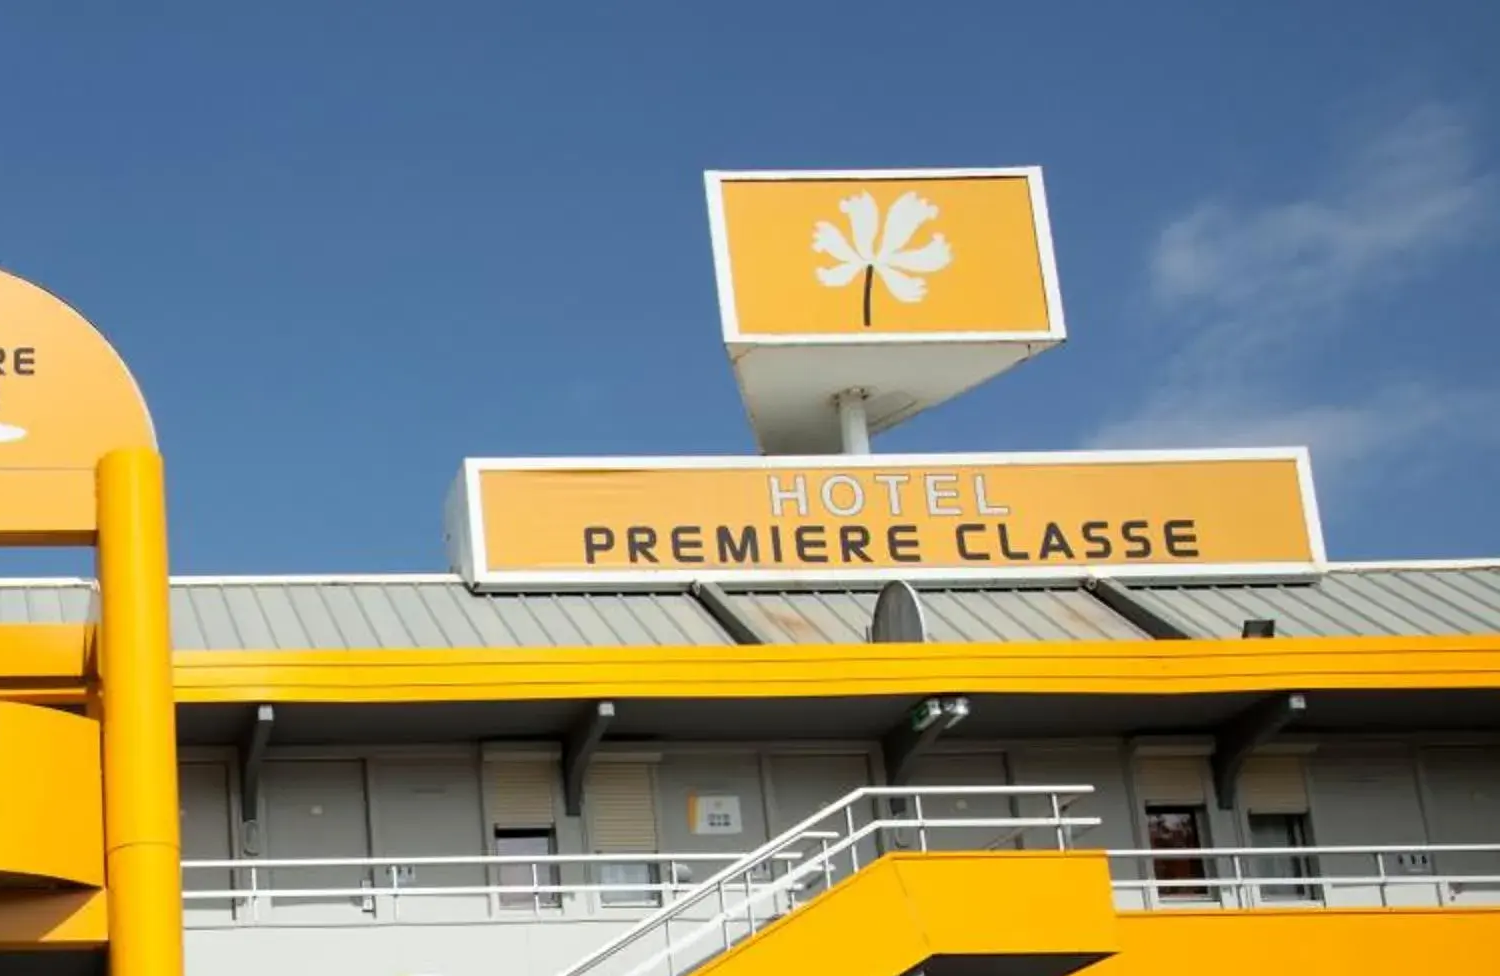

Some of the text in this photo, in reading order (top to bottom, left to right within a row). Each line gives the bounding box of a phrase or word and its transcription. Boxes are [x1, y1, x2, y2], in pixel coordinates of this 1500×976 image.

[767, 473, 1012, 518] HOTEL
[583, 519, 1200, 565] PREMIERE CLASSE
